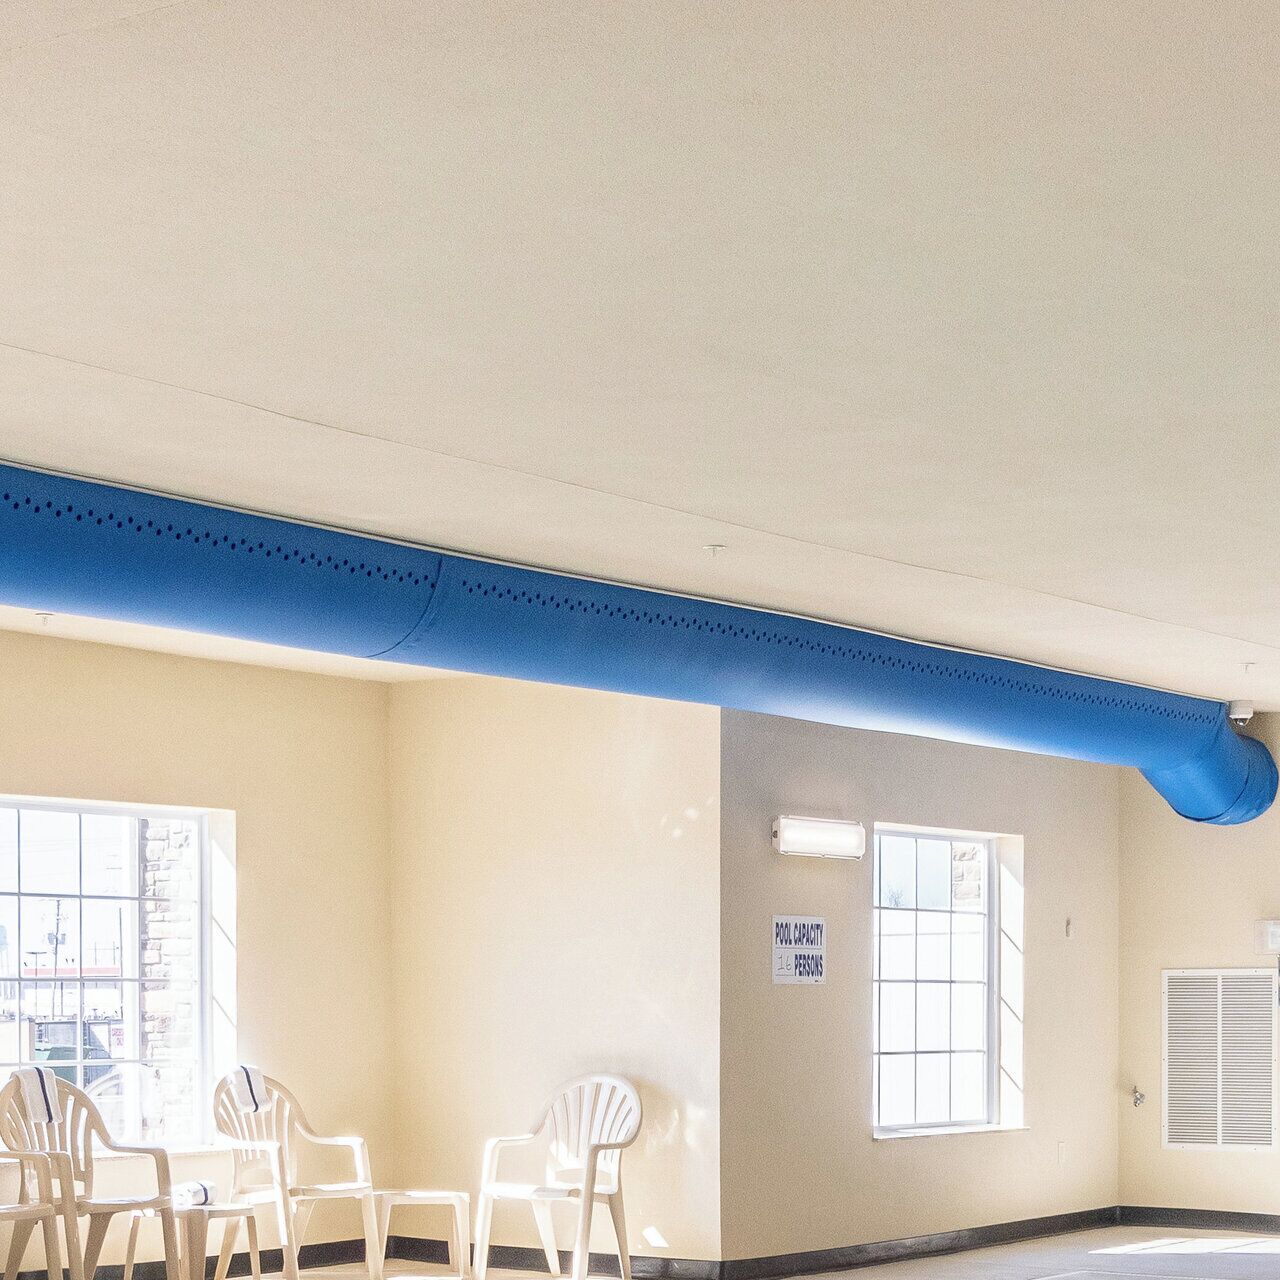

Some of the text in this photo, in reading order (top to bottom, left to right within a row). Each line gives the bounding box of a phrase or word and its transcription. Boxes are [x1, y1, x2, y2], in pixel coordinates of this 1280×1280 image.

[775, 922, 823, 946] POOL CAPACITY
[794, 954, 823, 977] PERSONS
